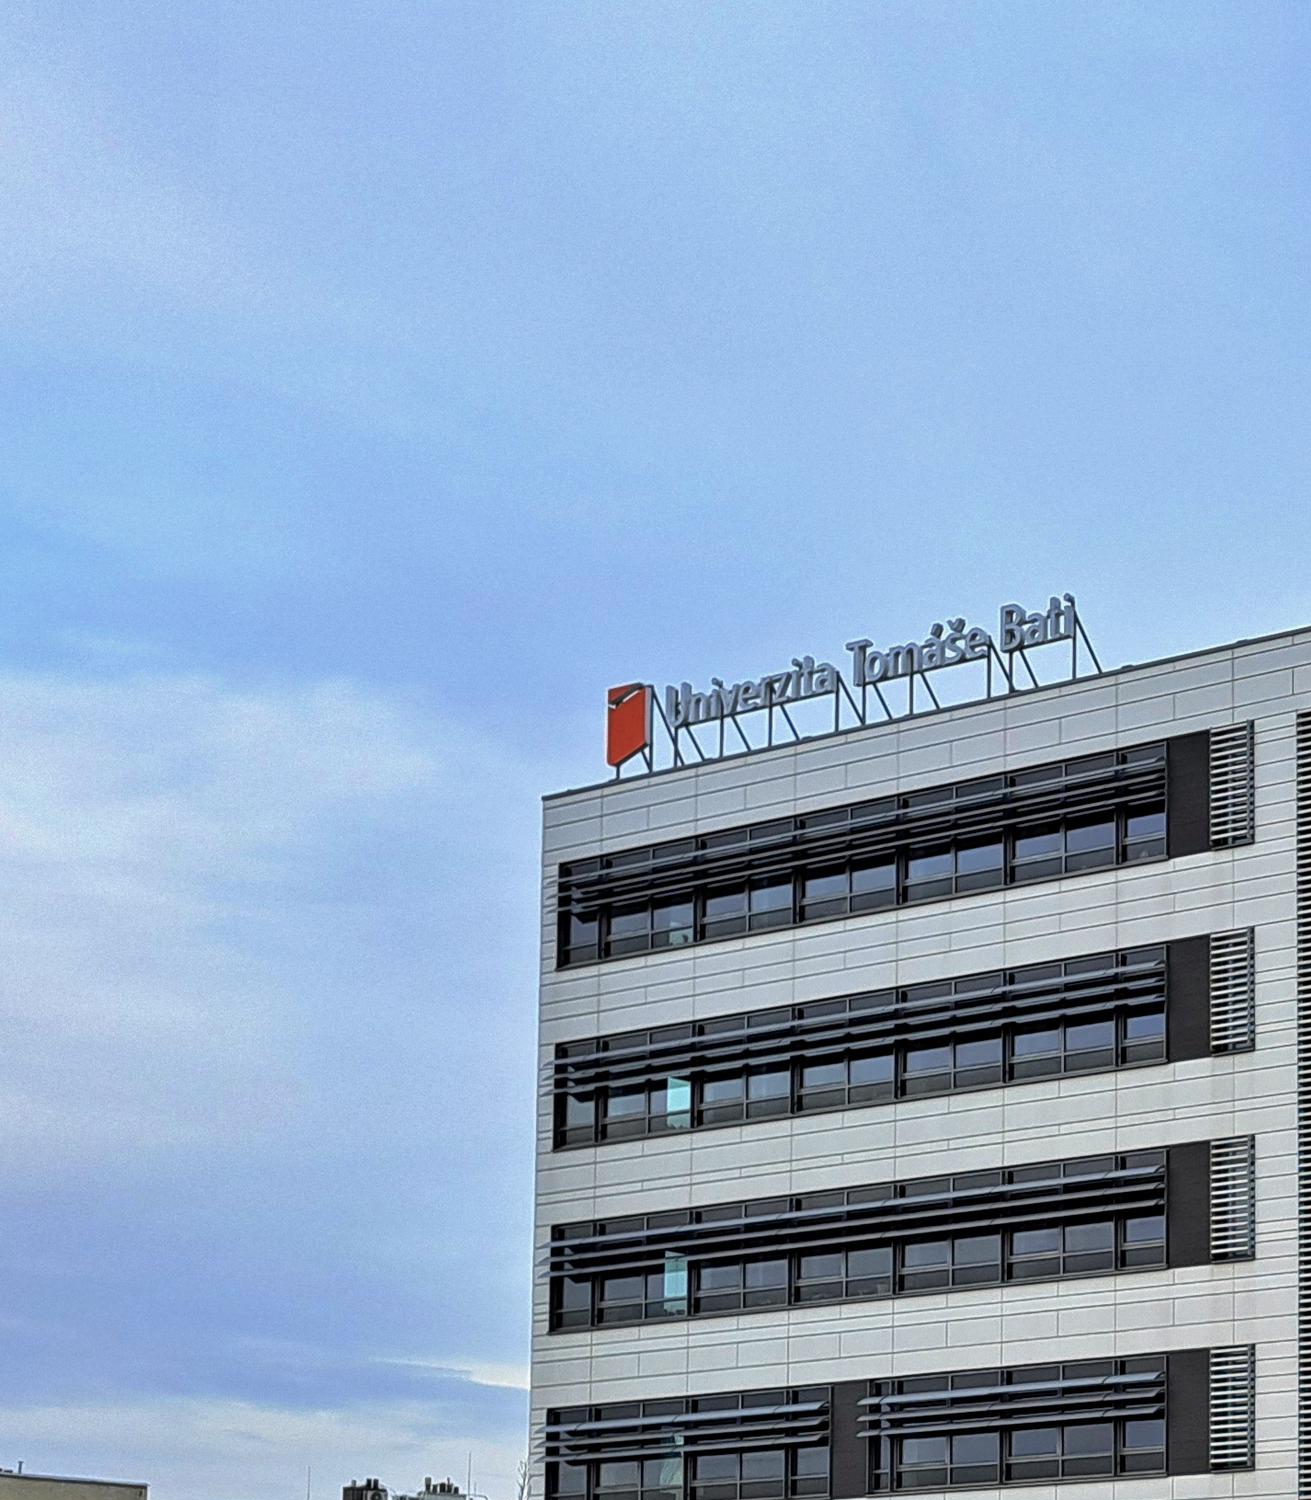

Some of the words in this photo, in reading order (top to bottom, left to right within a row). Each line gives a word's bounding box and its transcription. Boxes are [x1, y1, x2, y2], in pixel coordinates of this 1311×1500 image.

[664, 655, 837, 729] Univerzita
[845, 617, 991, 687] Tomáše
[1000, 593, 1076, 654] Bati
